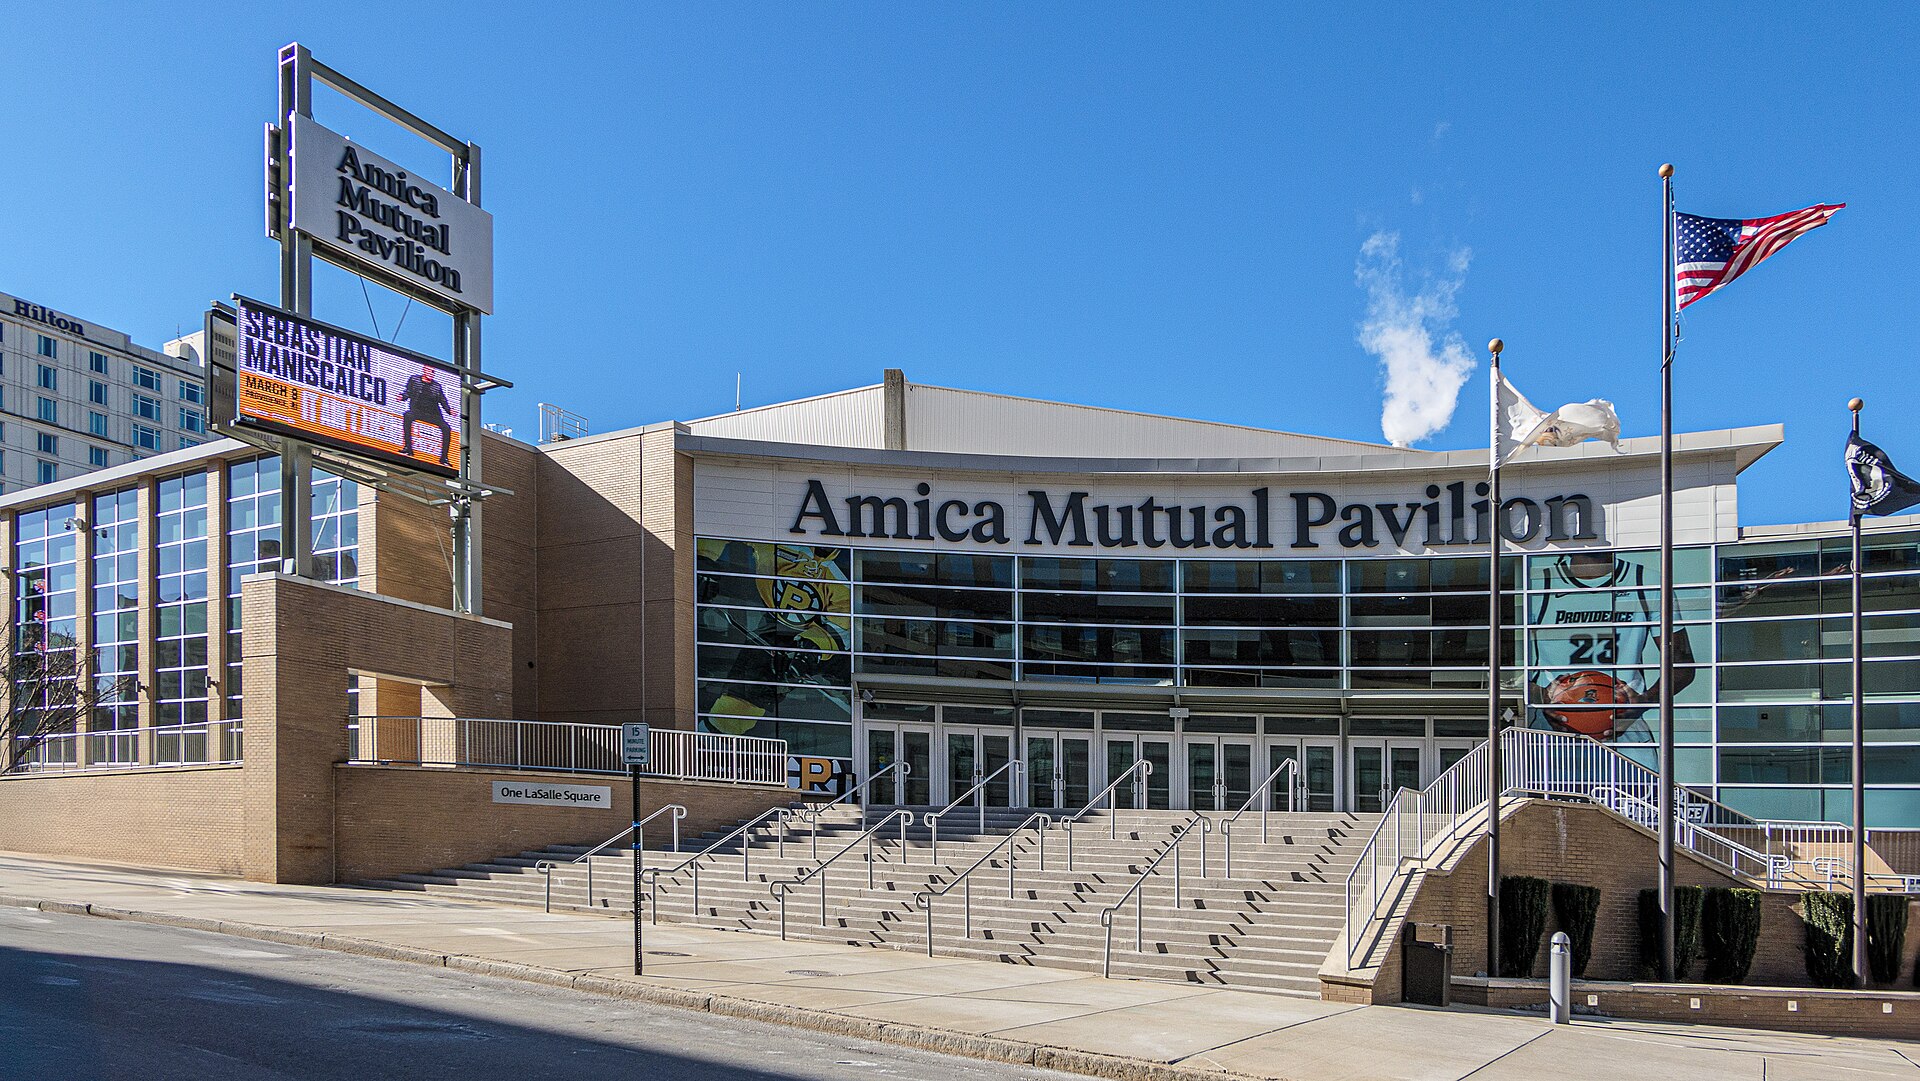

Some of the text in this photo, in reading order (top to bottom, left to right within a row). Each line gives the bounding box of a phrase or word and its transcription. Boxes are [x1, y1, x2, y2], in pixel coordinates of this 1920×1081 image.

[336, 146, 441, 219] Amica
[336, 176, 452, 256] Mutual
[336, 210, 464, 294] Pavilion
[13, 299, 85, 336] Hilton
[246, 311, 371, 374] SEBASTIAN
[245, 337, 387, 406] MANISCALCO
[246, 376, 287, 398] MARCH
[789, 479, 1598, 549] Amica Mutual Pavilion
[1555, 610, 1635, 625] PROVIDENCE
[1569, 633, 1621, 665] 23
[632, 727, 640, 737] 15
[501, 787, 601, 803] One LaSalle Square
